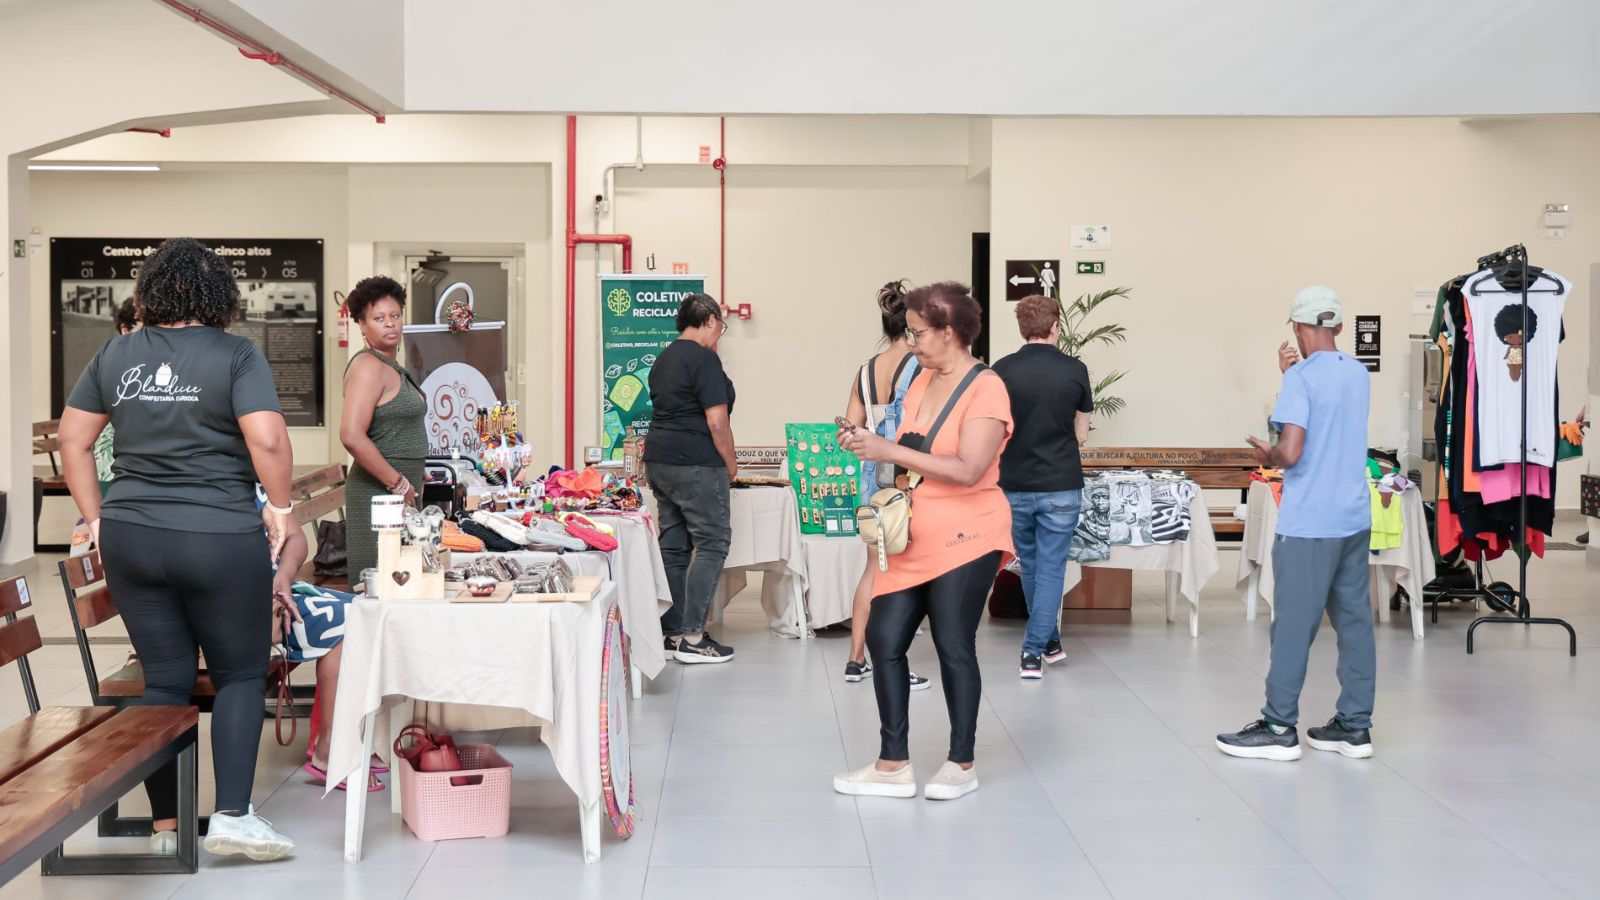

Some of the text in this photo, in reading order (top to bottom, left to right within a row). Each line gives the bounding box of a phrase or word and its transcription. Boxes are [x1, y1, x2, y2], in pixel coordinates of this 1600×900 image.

[102, 246, 142, 256] Centro
[214, 245, 246, 256] cinco
[246, 246, 272, 256] atos
[81, 268, 94, 278] 01
[231, 268, 247, 278] 04
[282, 268, 298, 278] 05
[138, 394, 175, 402] CONFEITARIA
